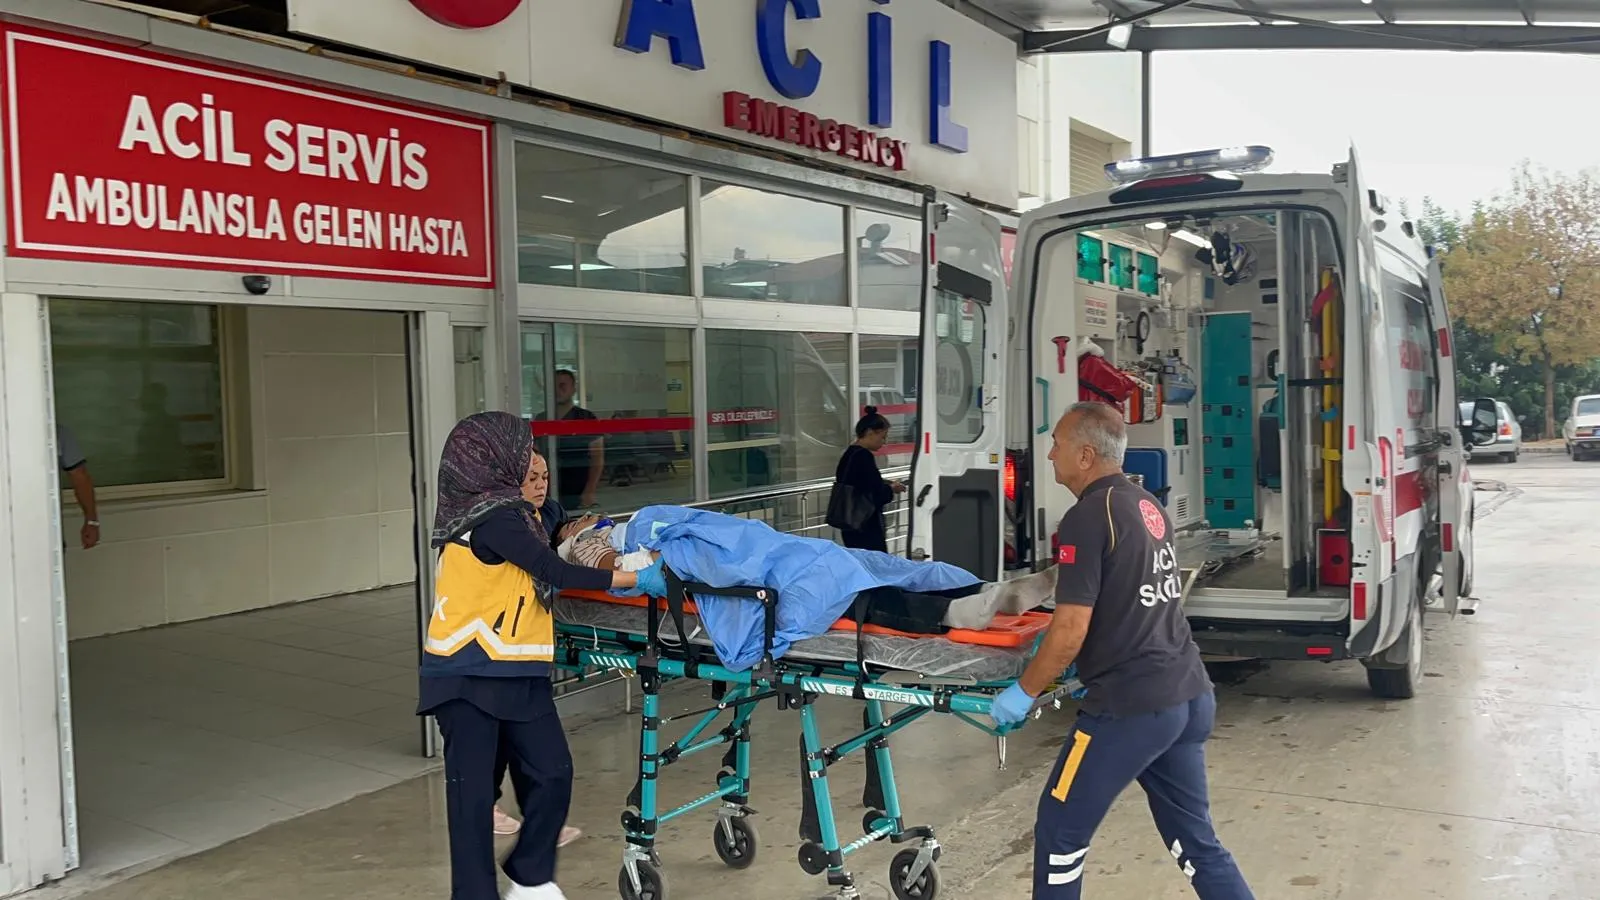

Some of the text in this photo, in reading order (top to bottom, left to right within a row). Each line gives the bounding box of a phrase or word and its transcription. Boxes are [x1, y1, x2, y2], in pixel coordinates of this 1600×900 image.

[118, 93, 428, 190] ACİL SERVİS
[723, 91, 911, 171] EMERGENCY
[46, 172, 469, 257] AMBULANSLA GELEN HASTA
[1152, 542, 1178, 574] ACİ
[873, 689, 913, 703] TARGET
